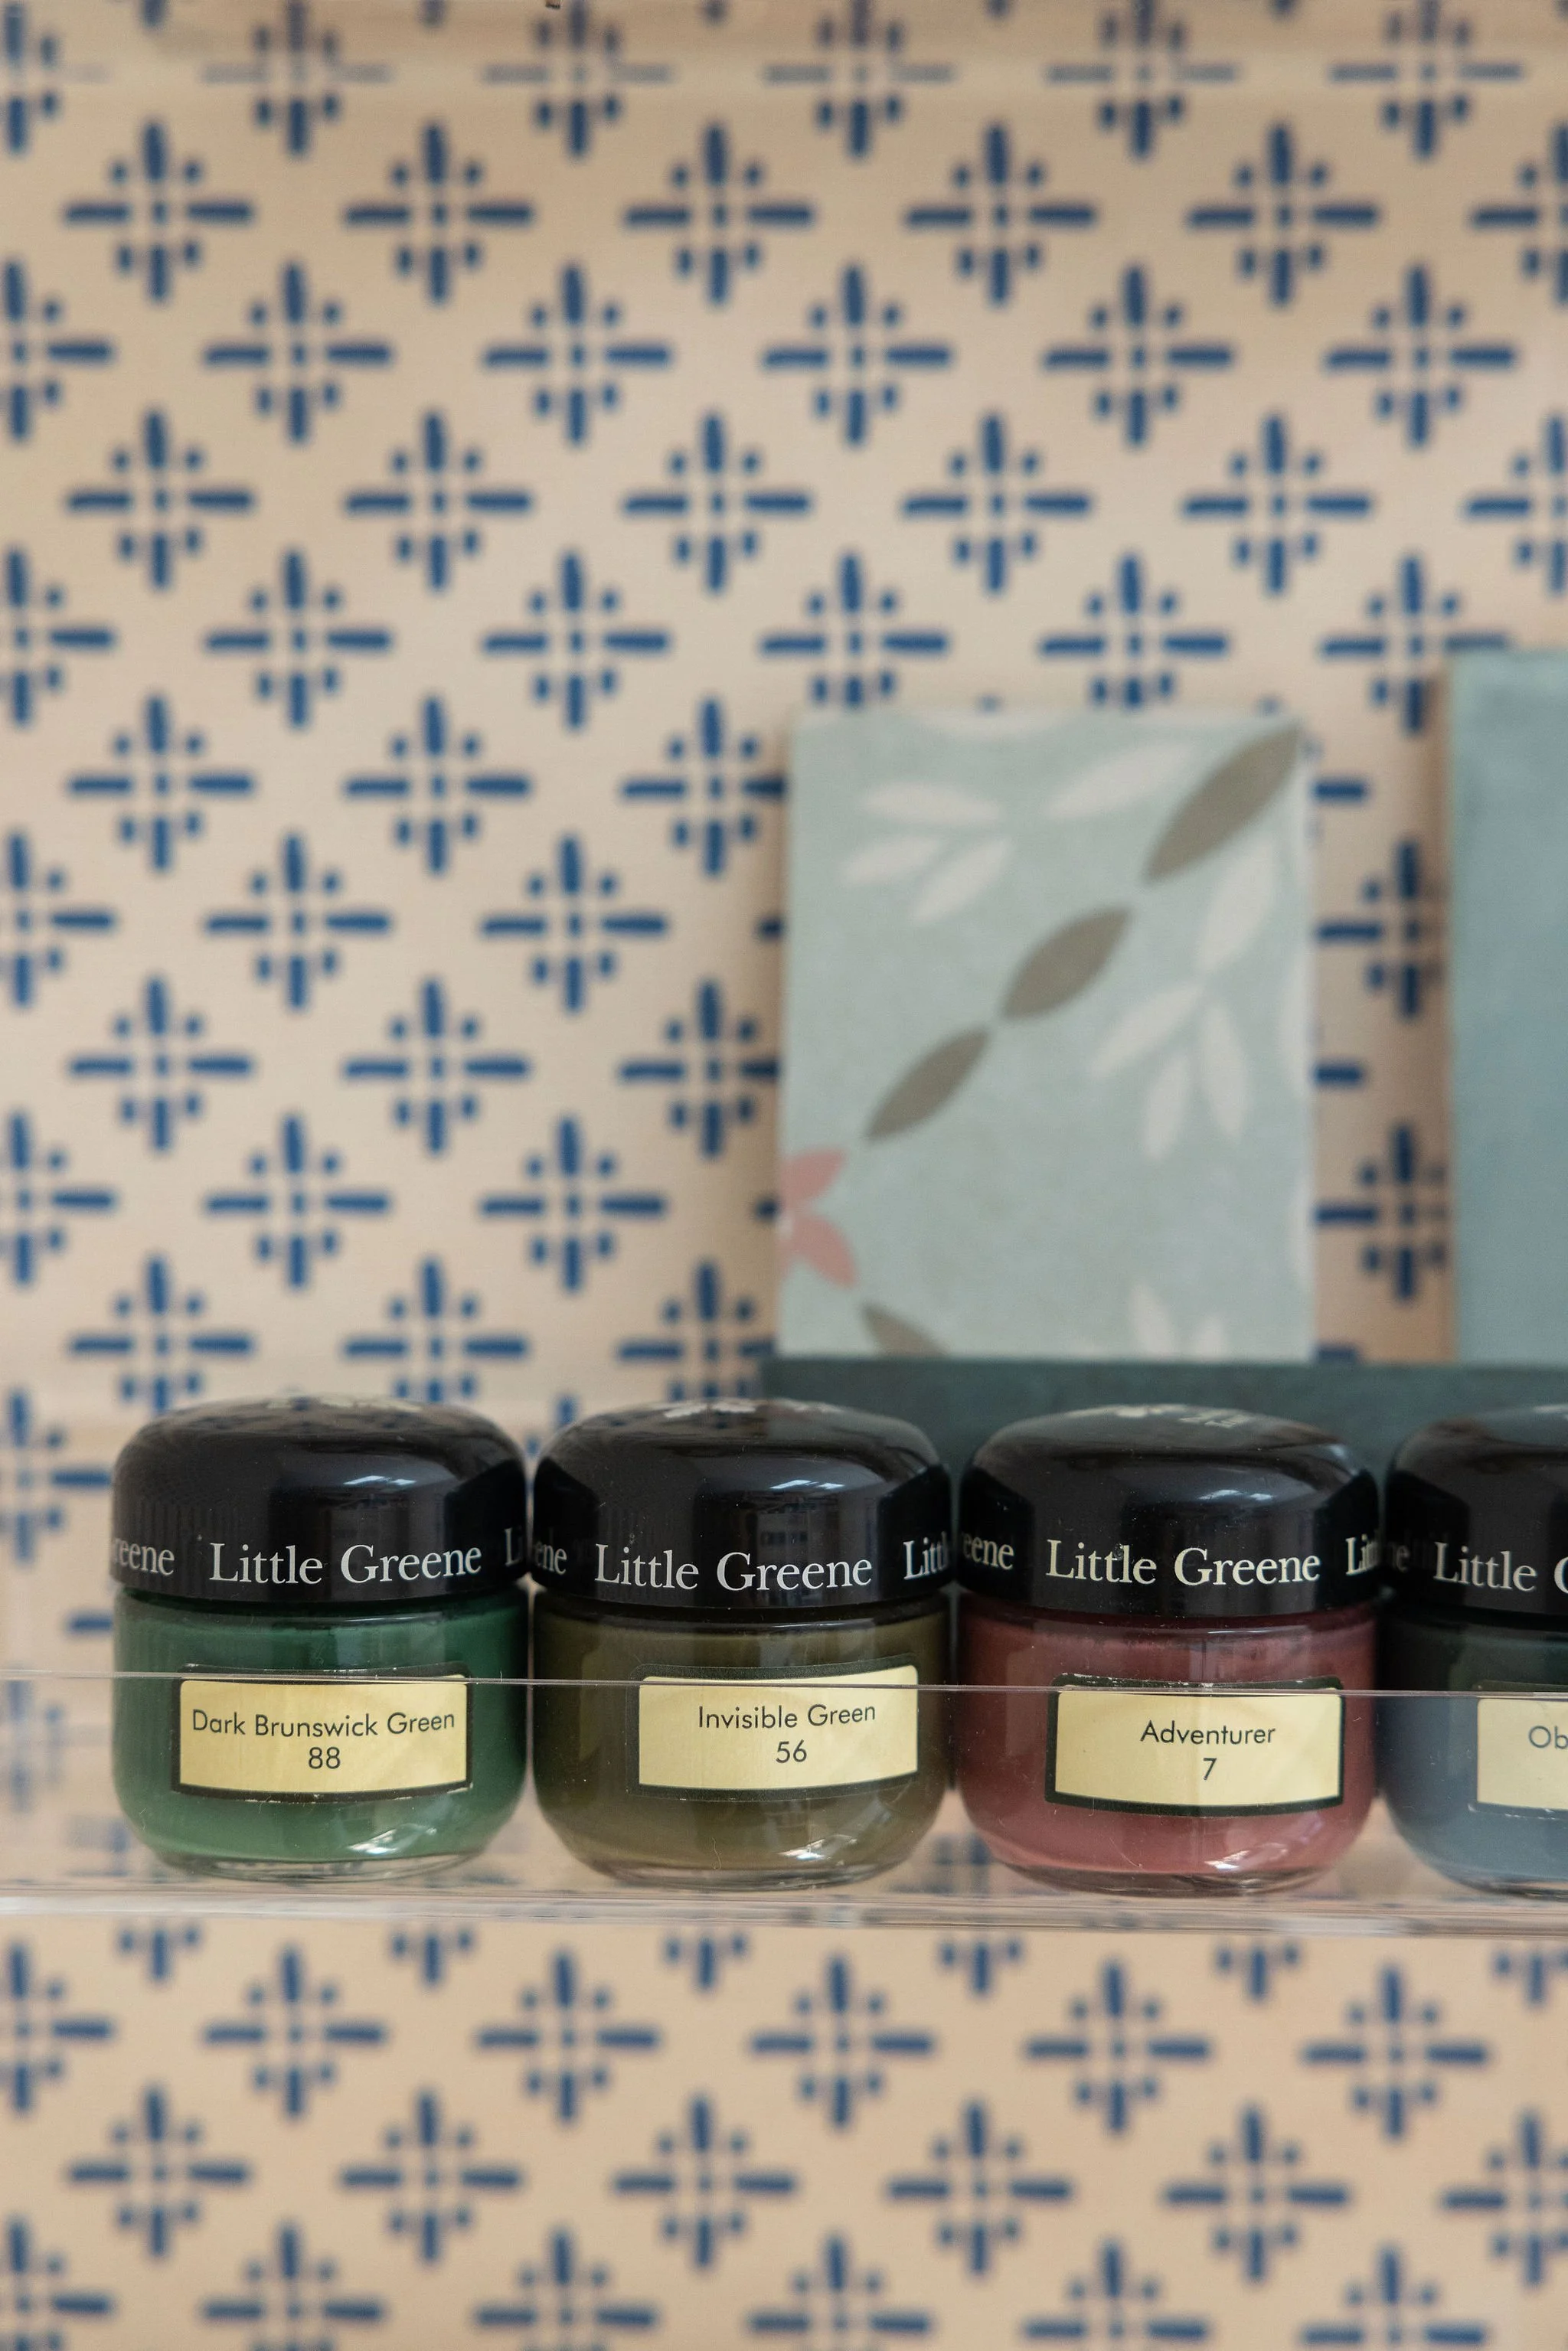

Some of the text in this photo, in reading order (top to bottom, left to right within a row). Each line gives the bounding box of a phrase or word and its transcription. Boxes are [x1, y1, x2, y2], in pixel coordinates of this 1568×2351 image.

[210, 1543, 323, 1585] Little
[341, 1544, 482, 1584] Greene
[595, 1543, 872, 1592] Little Greene
[1047, 1539, 1321, 1586] Little Greene
[1432, 1541, 1538, 1592] Little
[192, 1709, 455, 1738] Dark Brunswick Green
[698, 1704, 876, 1729] Invisible Green
[1140, 1720, 1276, 1745] Adventurer
[308, 1746, 341, 1769] 88
[775, 1739, 807, 1763] 56
[1203, 1758, 1217, 1781] 7
